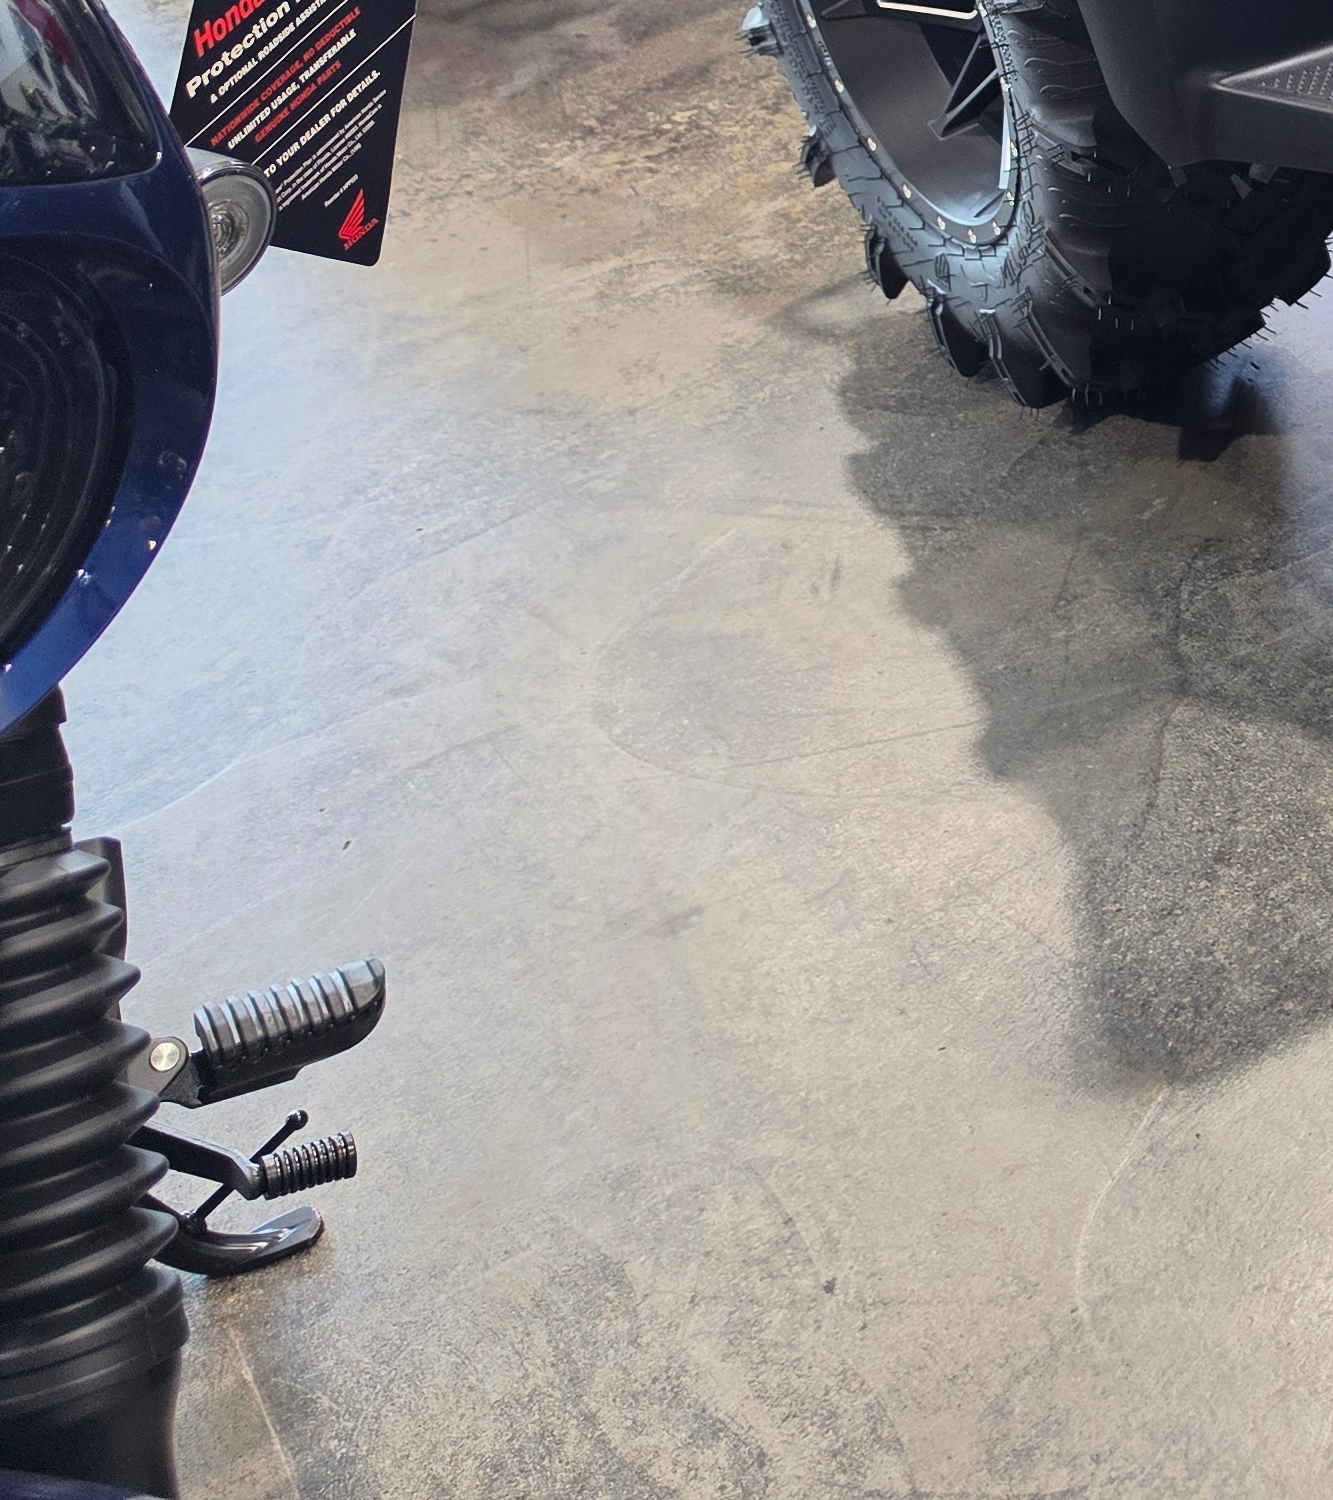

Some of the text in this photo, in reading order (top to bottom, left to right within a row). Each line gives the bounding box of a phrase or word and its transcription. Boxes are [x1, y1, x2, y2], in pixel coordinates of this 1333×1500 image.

[185, 1, 291, 98] Protection
[210, 93, 218, 103] &
[218, 58, 258, 96] OPTIONAL
[258, 22, 296, 61] ROADSIDE
[211, 6, 361, 147] NATIONWIDE COVERAGE, NO DEDUCTIBLE
[228, 28, 357, 149] UNLIMITED USAGE, TRANSFERABLE
[254, 60, 342, 143] GENUINE HONDA PARTS
[264, 69, 381, 178] TO YOUR DEALER FOR DETAILS.
[343, 217, 380, 250] HONDA
